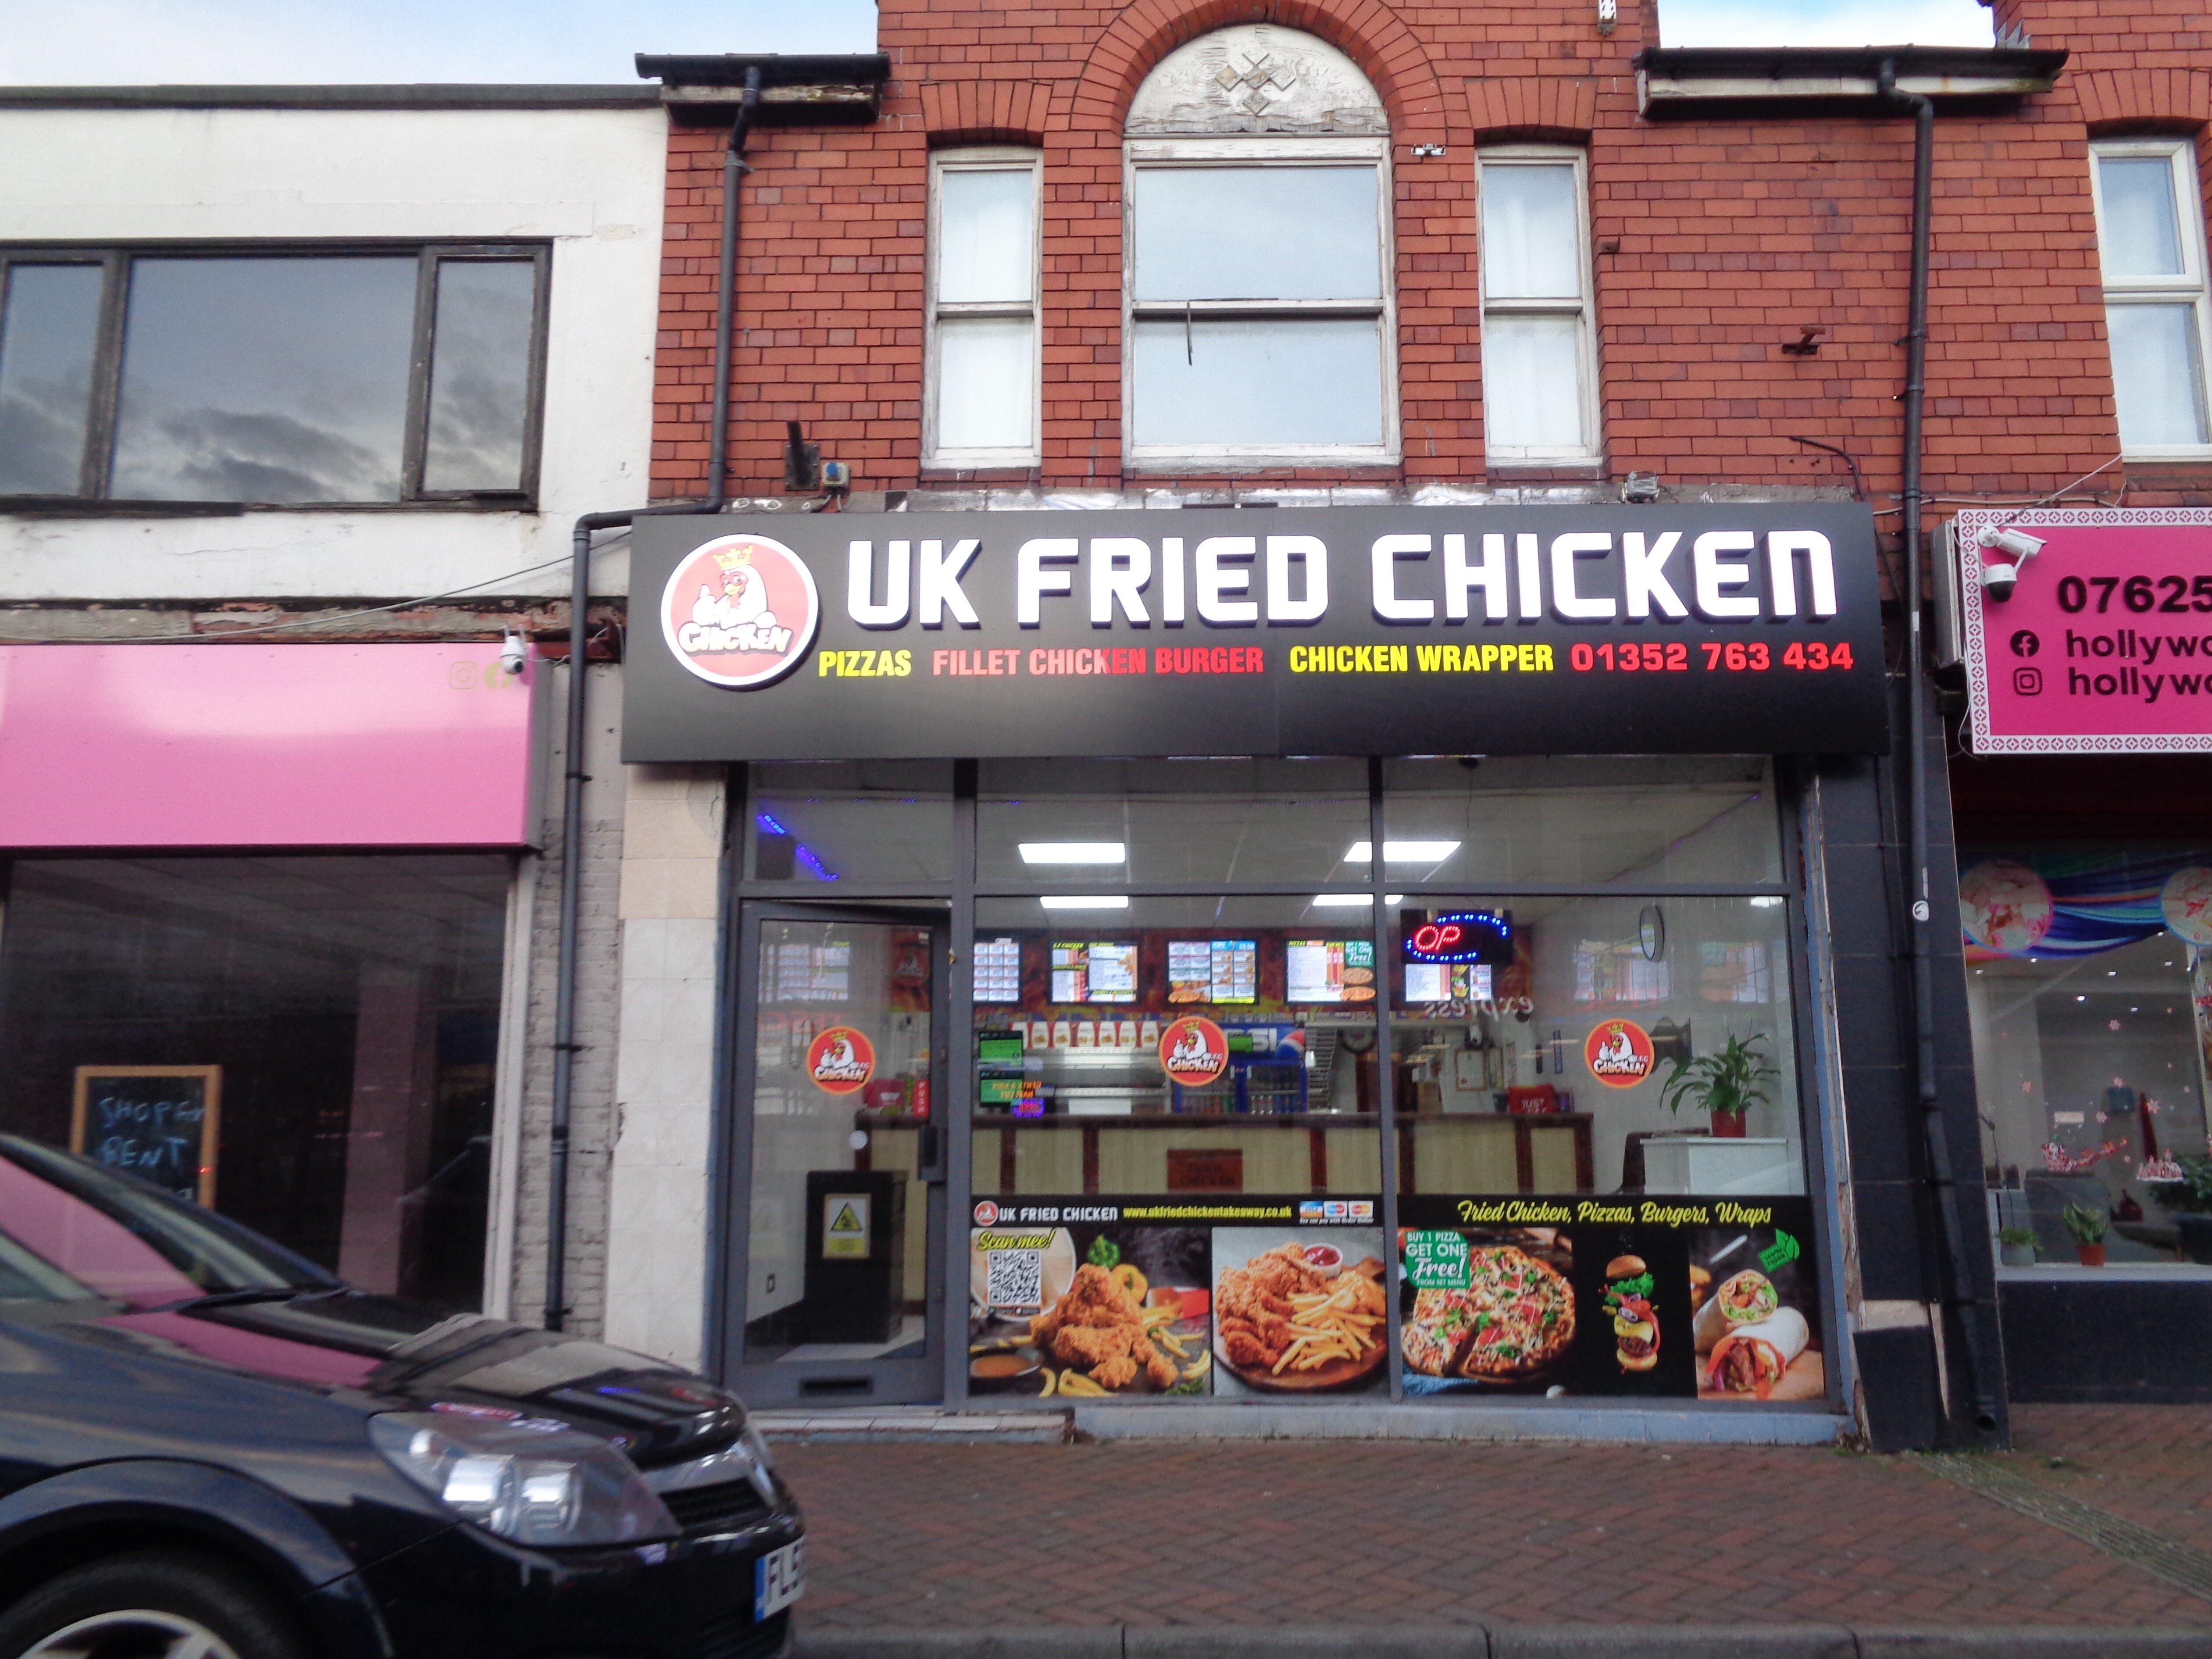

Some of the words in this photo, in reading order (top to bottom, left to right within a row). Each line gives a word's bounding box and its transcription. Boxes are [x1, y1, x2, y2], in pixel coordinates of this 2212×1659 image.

[847, 539, 981, 626] UK
[1017, 535, 1329, 624] FRIED
[1371, 530, 1837, 622] CHICKEN
[2057, 575, 2212, 614] 07625
[678, 621, 792, 654] CHICKEN
[818, 650, 913, 677] PIZZAS
[932, 648, 1024, 676] FILLET
[1028, 648, 1147, 676] CHICKEN
[1155, 646, 1265, 675] BURGER
[1289, 645, 1409, 673] CHICKEN
[1415, 644, 1555, 673] WRAPPER
[1570, 642, 1689, 672] 01352
[1701, 642, 1771, 671] 763
[1782, 642, 1854, 671] 434
[814, 1065, 867, 1082] CHICKEN
[1166, 1055, 1220, 1074] CHICKEN
[1593, 1060, 1645, 1076] CHICKEN
[101, 1135, 187, 1167] RENT
[999, 1206, 1016, 1221] UK
[1020, 1207, 1059, 1222] FRIED
[1063, 1206, 1119, 1222] CHICKEN
[1123, 1205, 1293, 1219] www.ukfriedchickentakeaway.co.uk
[1457, 1200, 1506, 1223] Fried
[1506, 1200, 1572, 1224] Chicken,
[1577, 1201, 1635, 1224] Pizzas,
[1640, 1201, 1710, 1227] Burgers,
[1715, 1201, 1772, 1228] Wraps
[978, 1230, 1017, 1251] Scan
[1406, 1243, 1433, 1257] GET
[1436, 1243, 1468, 1256] ONE
[1407, 1232, 1424, 1242] BUY
[1427, 1232, 1432, 1242] 1
[1435, 1232, 1461, 1242] PIZZA
[1412, 1255, 1467, 1280] Free!
